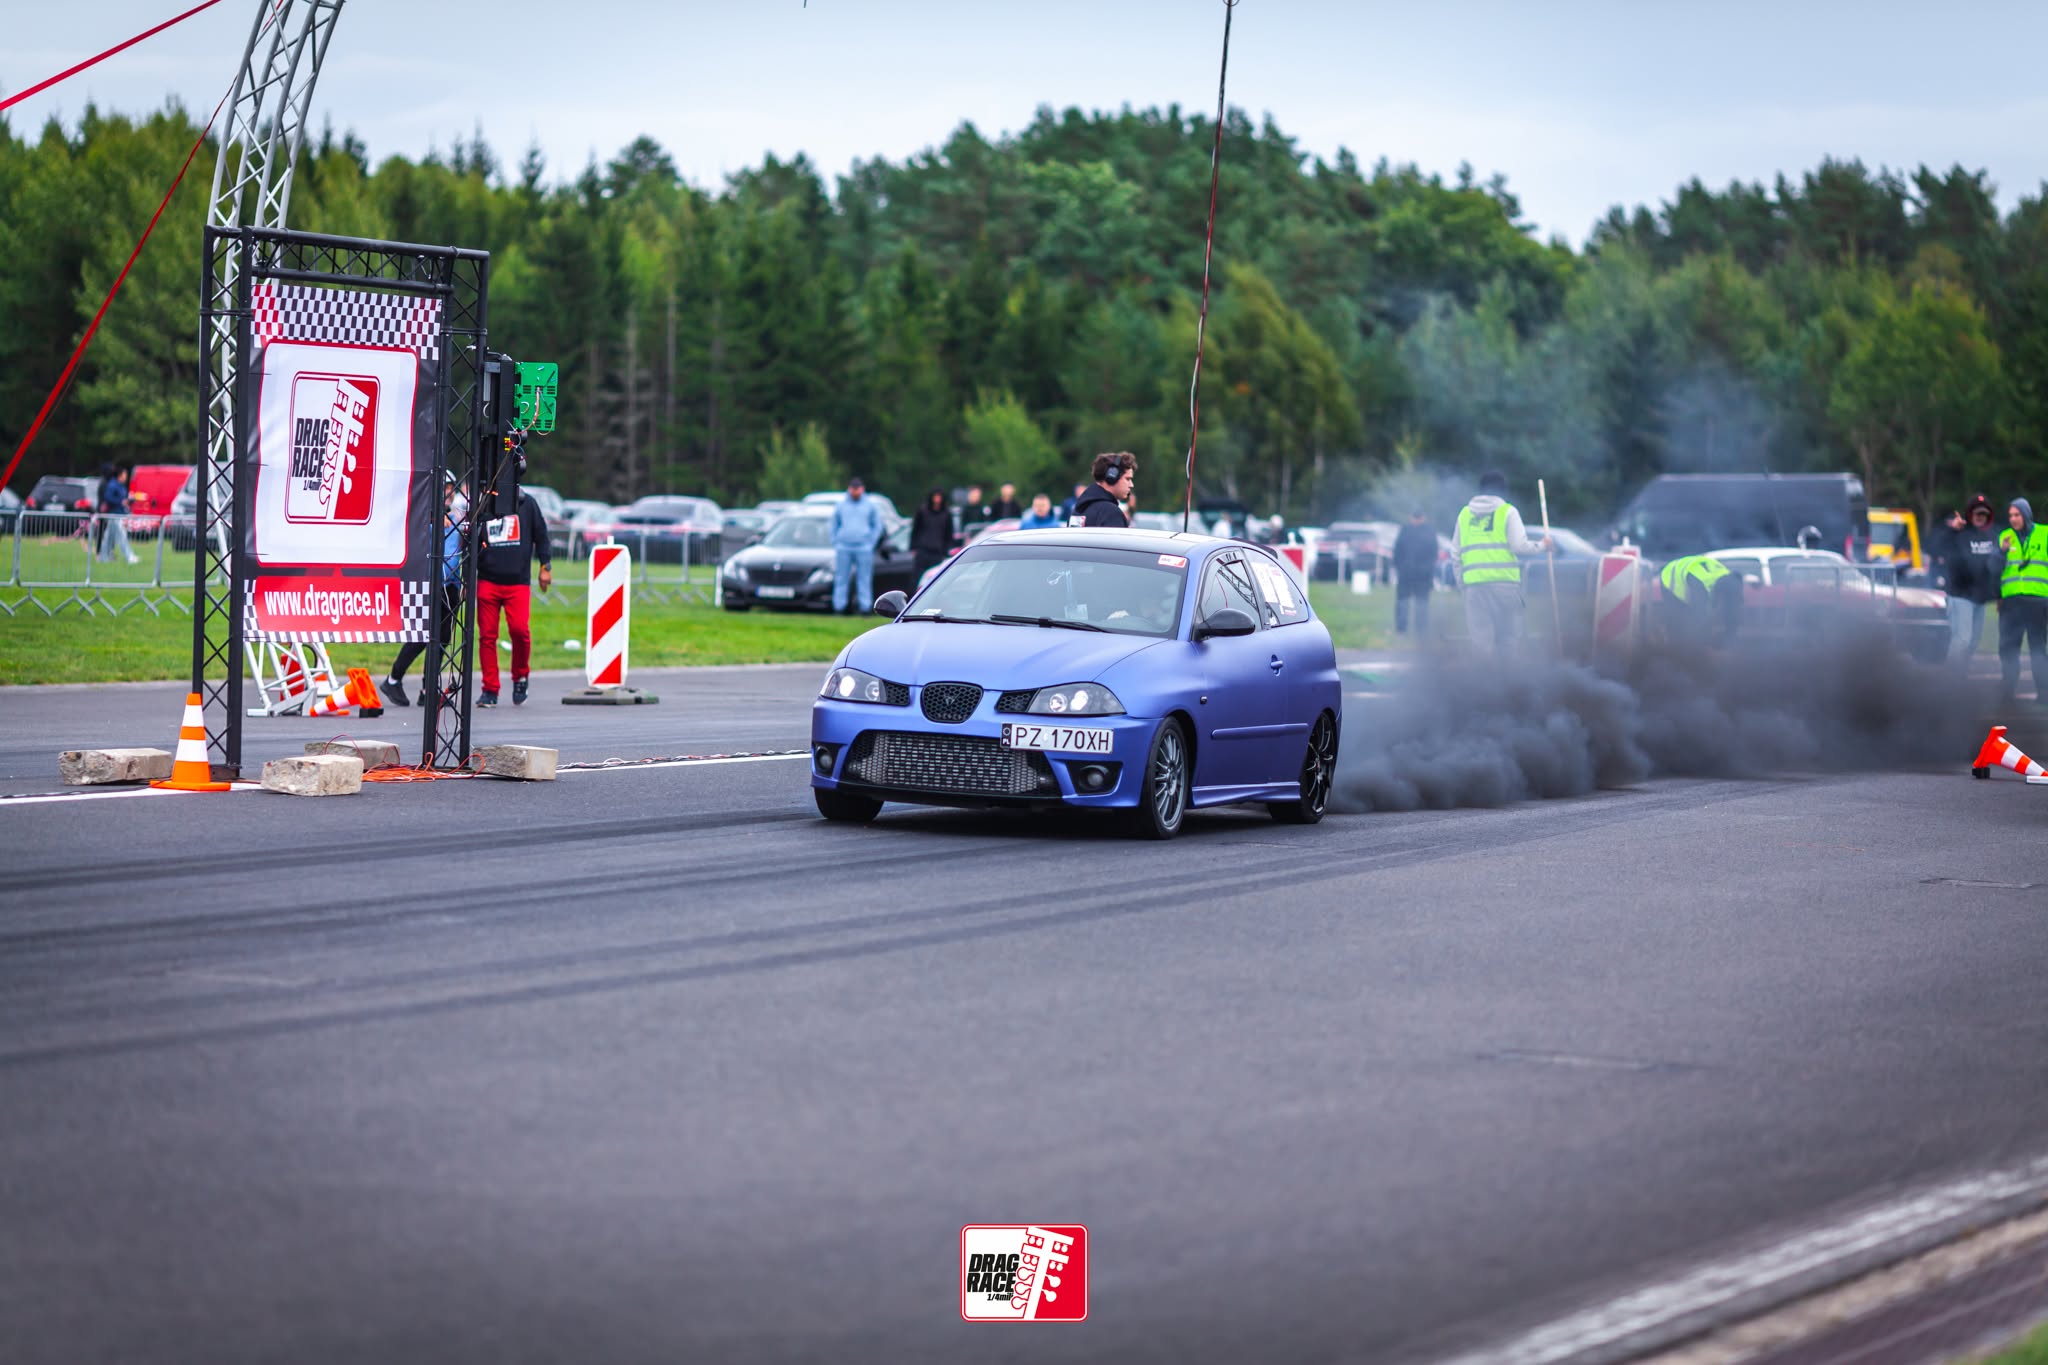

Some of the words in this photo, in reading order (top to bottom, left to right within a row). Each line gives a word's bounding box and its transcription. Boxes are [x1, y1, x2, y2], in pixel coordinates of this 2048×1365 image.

[295, 418, 330, 447] DRAG
[292, 447, 326, 478] RACE
[264, 583, 390, 625] www.dragrace.pl
[1015, 727, 1042, 747] PZ
[1051, 729, 1110, 751] 170XH
